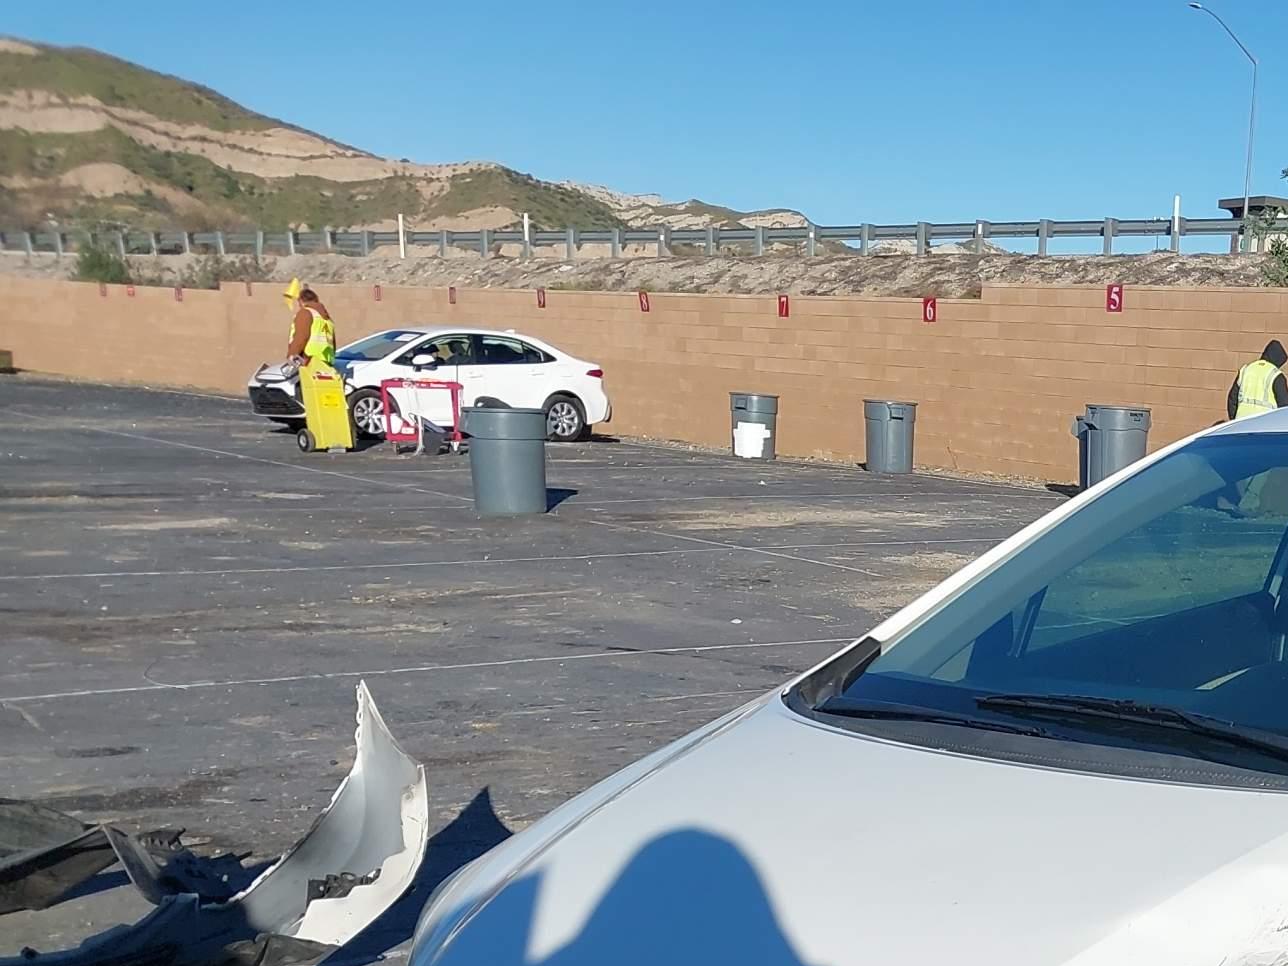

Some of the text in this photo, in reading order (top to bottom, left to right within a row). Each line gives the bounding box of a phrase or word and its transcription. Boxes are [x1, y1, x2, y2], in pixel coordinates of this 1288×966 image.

[638, 294, 647, 311] 8
[780, 297, 788, 316] 7
[1110, 287, 1120, 309] 5
[926, 300, 934, 320] 6
